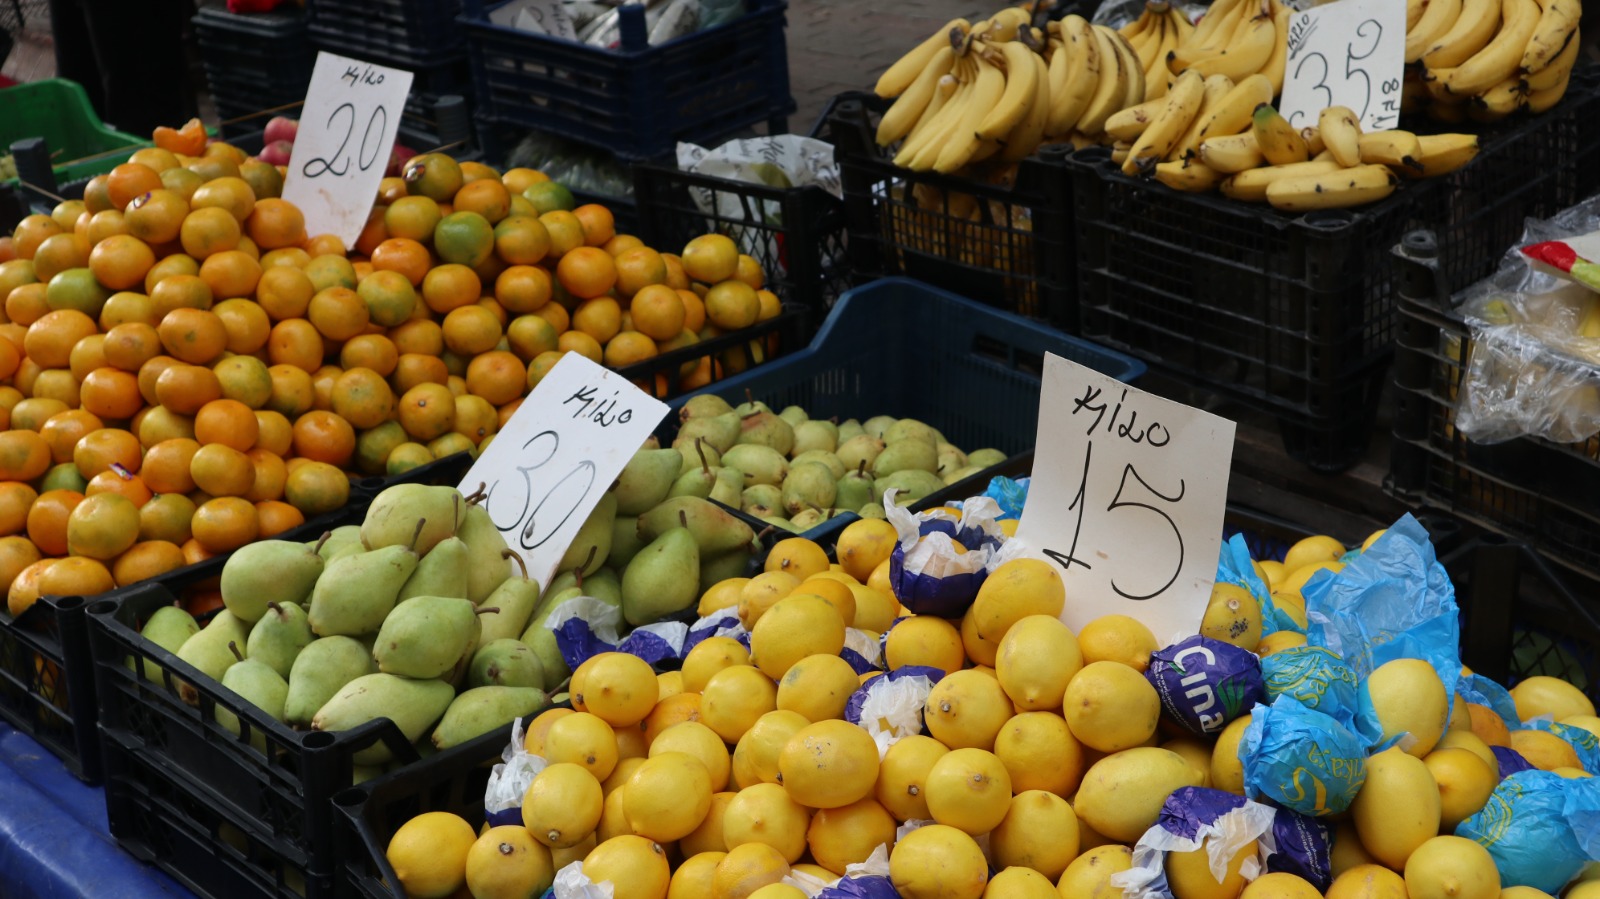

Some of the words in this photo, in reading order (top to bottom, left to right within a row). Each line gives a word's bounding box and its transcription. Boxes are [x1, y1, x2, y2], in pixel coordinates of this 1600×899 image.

[1289, 18, 1382, 127] 35
[303, 102, 387, 178] 20
[485, 429, 597, 550] 30
[1042, 440, 1185, 601] 15
[1173, 645, 1224, 733] Cina
